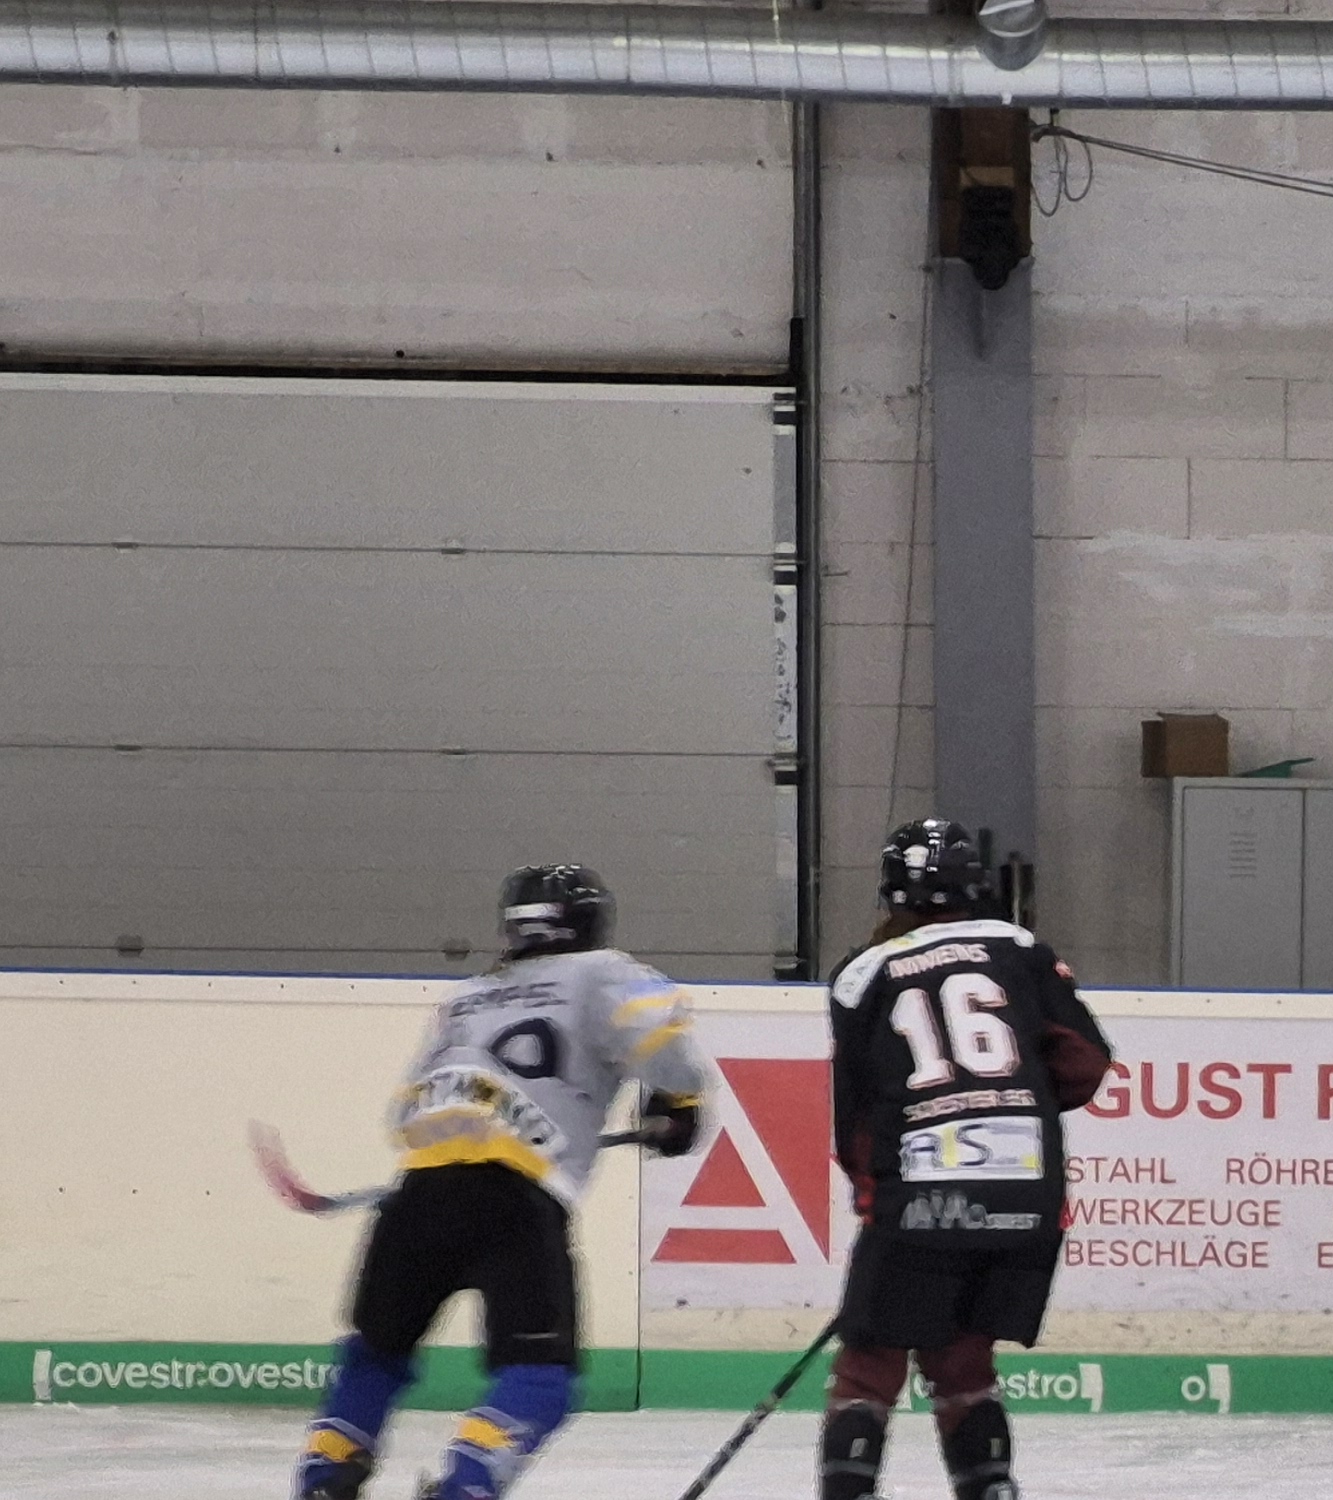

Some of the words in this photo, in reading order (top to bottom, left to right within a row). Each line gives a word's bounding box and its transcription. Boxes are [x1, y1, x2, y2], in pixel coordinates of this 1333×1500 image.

[889, 973, 1023, 1091] 16
[1082, 1061, 1293, 1122] GUST
[1064, 1155, 1177, 1185] STAHL
[1067, 1197, 1283, 1228] WERKZEUGE
[1064, 1235, 1270, 1269] BESCHLÄGE
